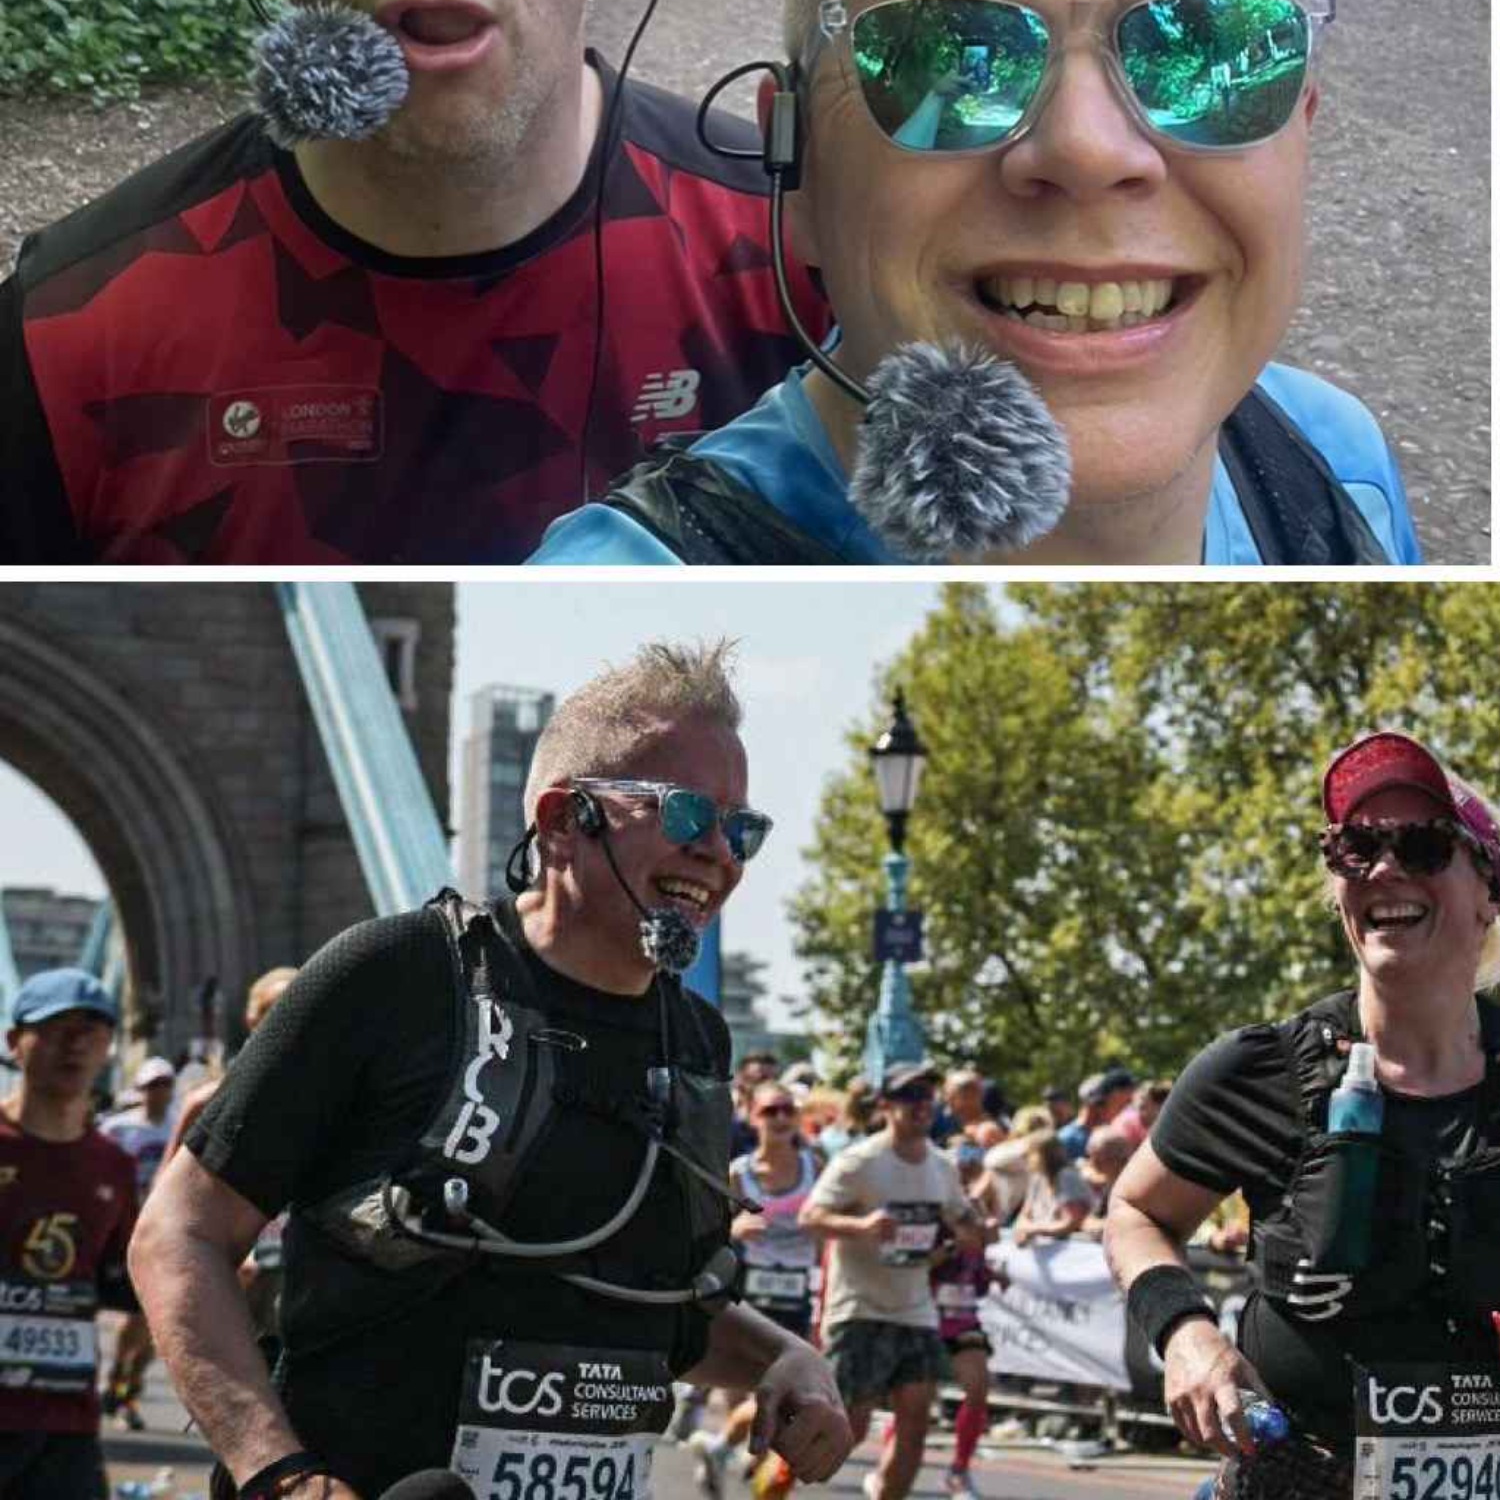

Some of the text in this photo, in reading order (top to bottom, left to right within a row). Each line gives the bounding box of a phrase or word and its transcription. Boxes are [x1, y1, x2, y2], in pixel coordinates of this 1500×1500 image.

[4, 1327, 80, 1357] 49533
[478, 1355, 565, 1416] tcs
[577, 1362, 622, 1381] TATA
[1451, 1374, 1493, 1388] TATA
[571, 1402, 638, 1420] SERVICES
[1368, 1376, 1444, 1424] tcs
[488, 1452, 635, 1500] 58594
